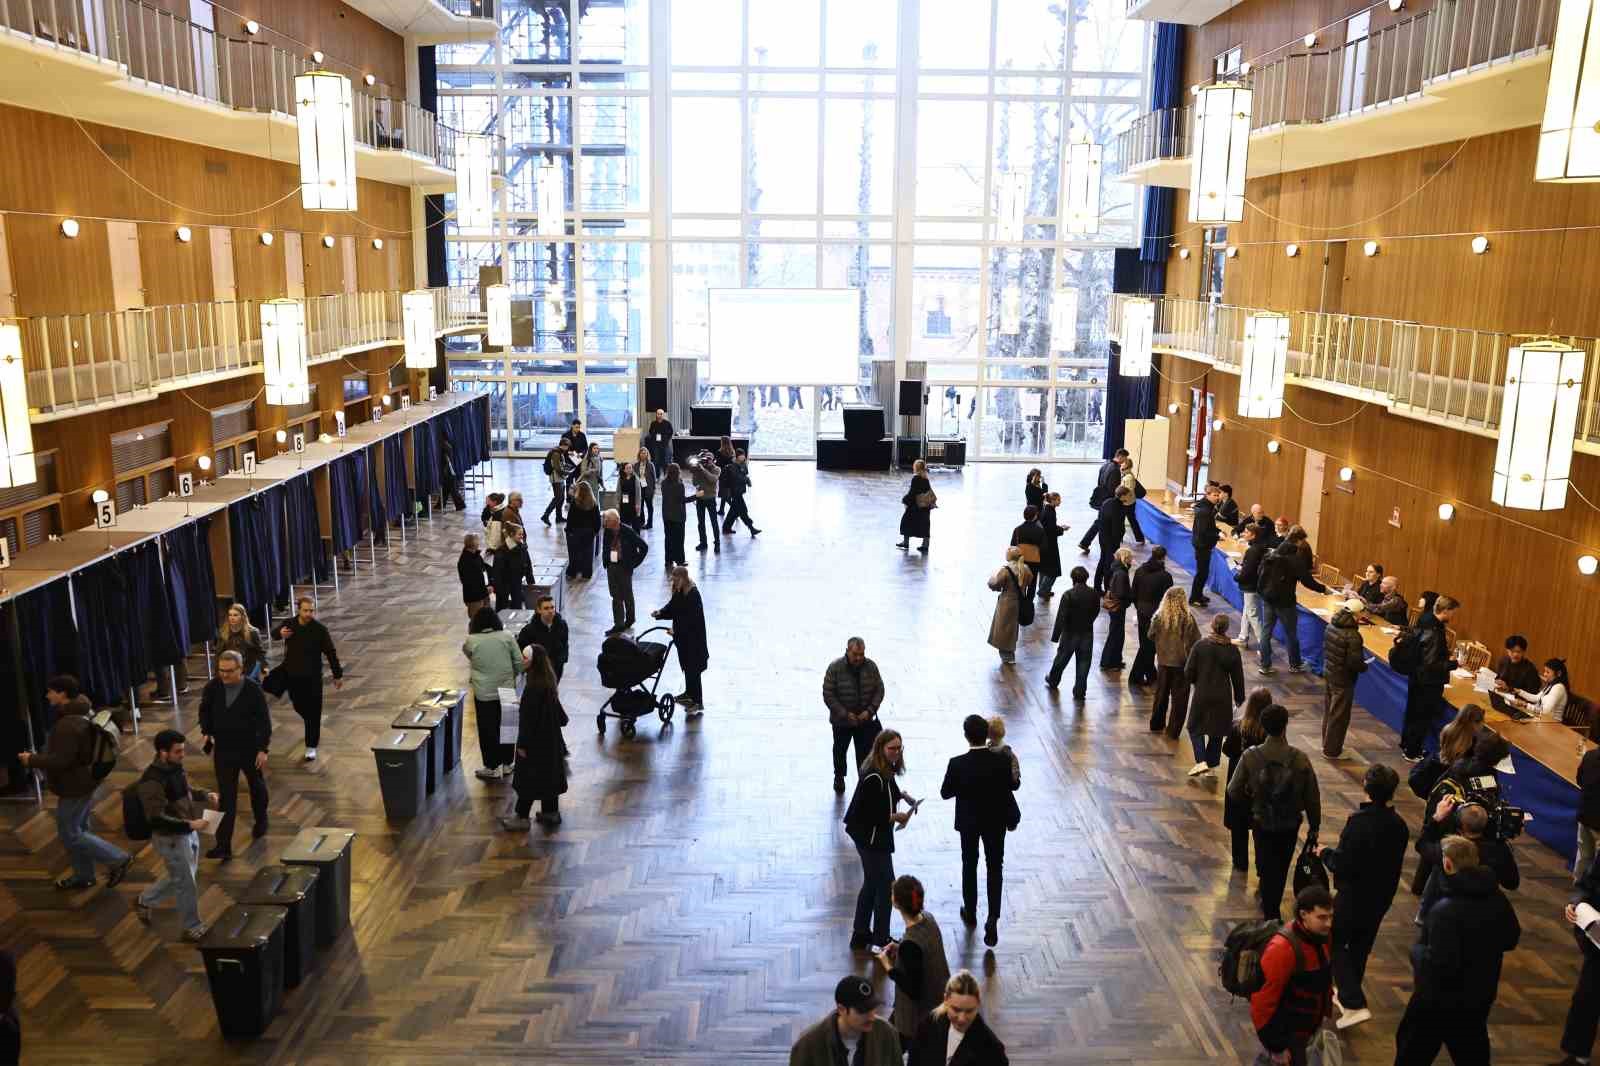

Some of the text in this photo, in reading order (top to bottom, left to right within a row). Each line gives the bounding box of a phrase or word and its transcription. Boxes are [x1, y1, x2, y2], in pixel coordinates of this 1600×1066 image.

[374, 409, 382, 420] 10
[296, 437, 302, 450] 8
[246, 456, 253, 469] 7
[182, 477, 191, 494] 6
[102, 505, 111, 524] 5
